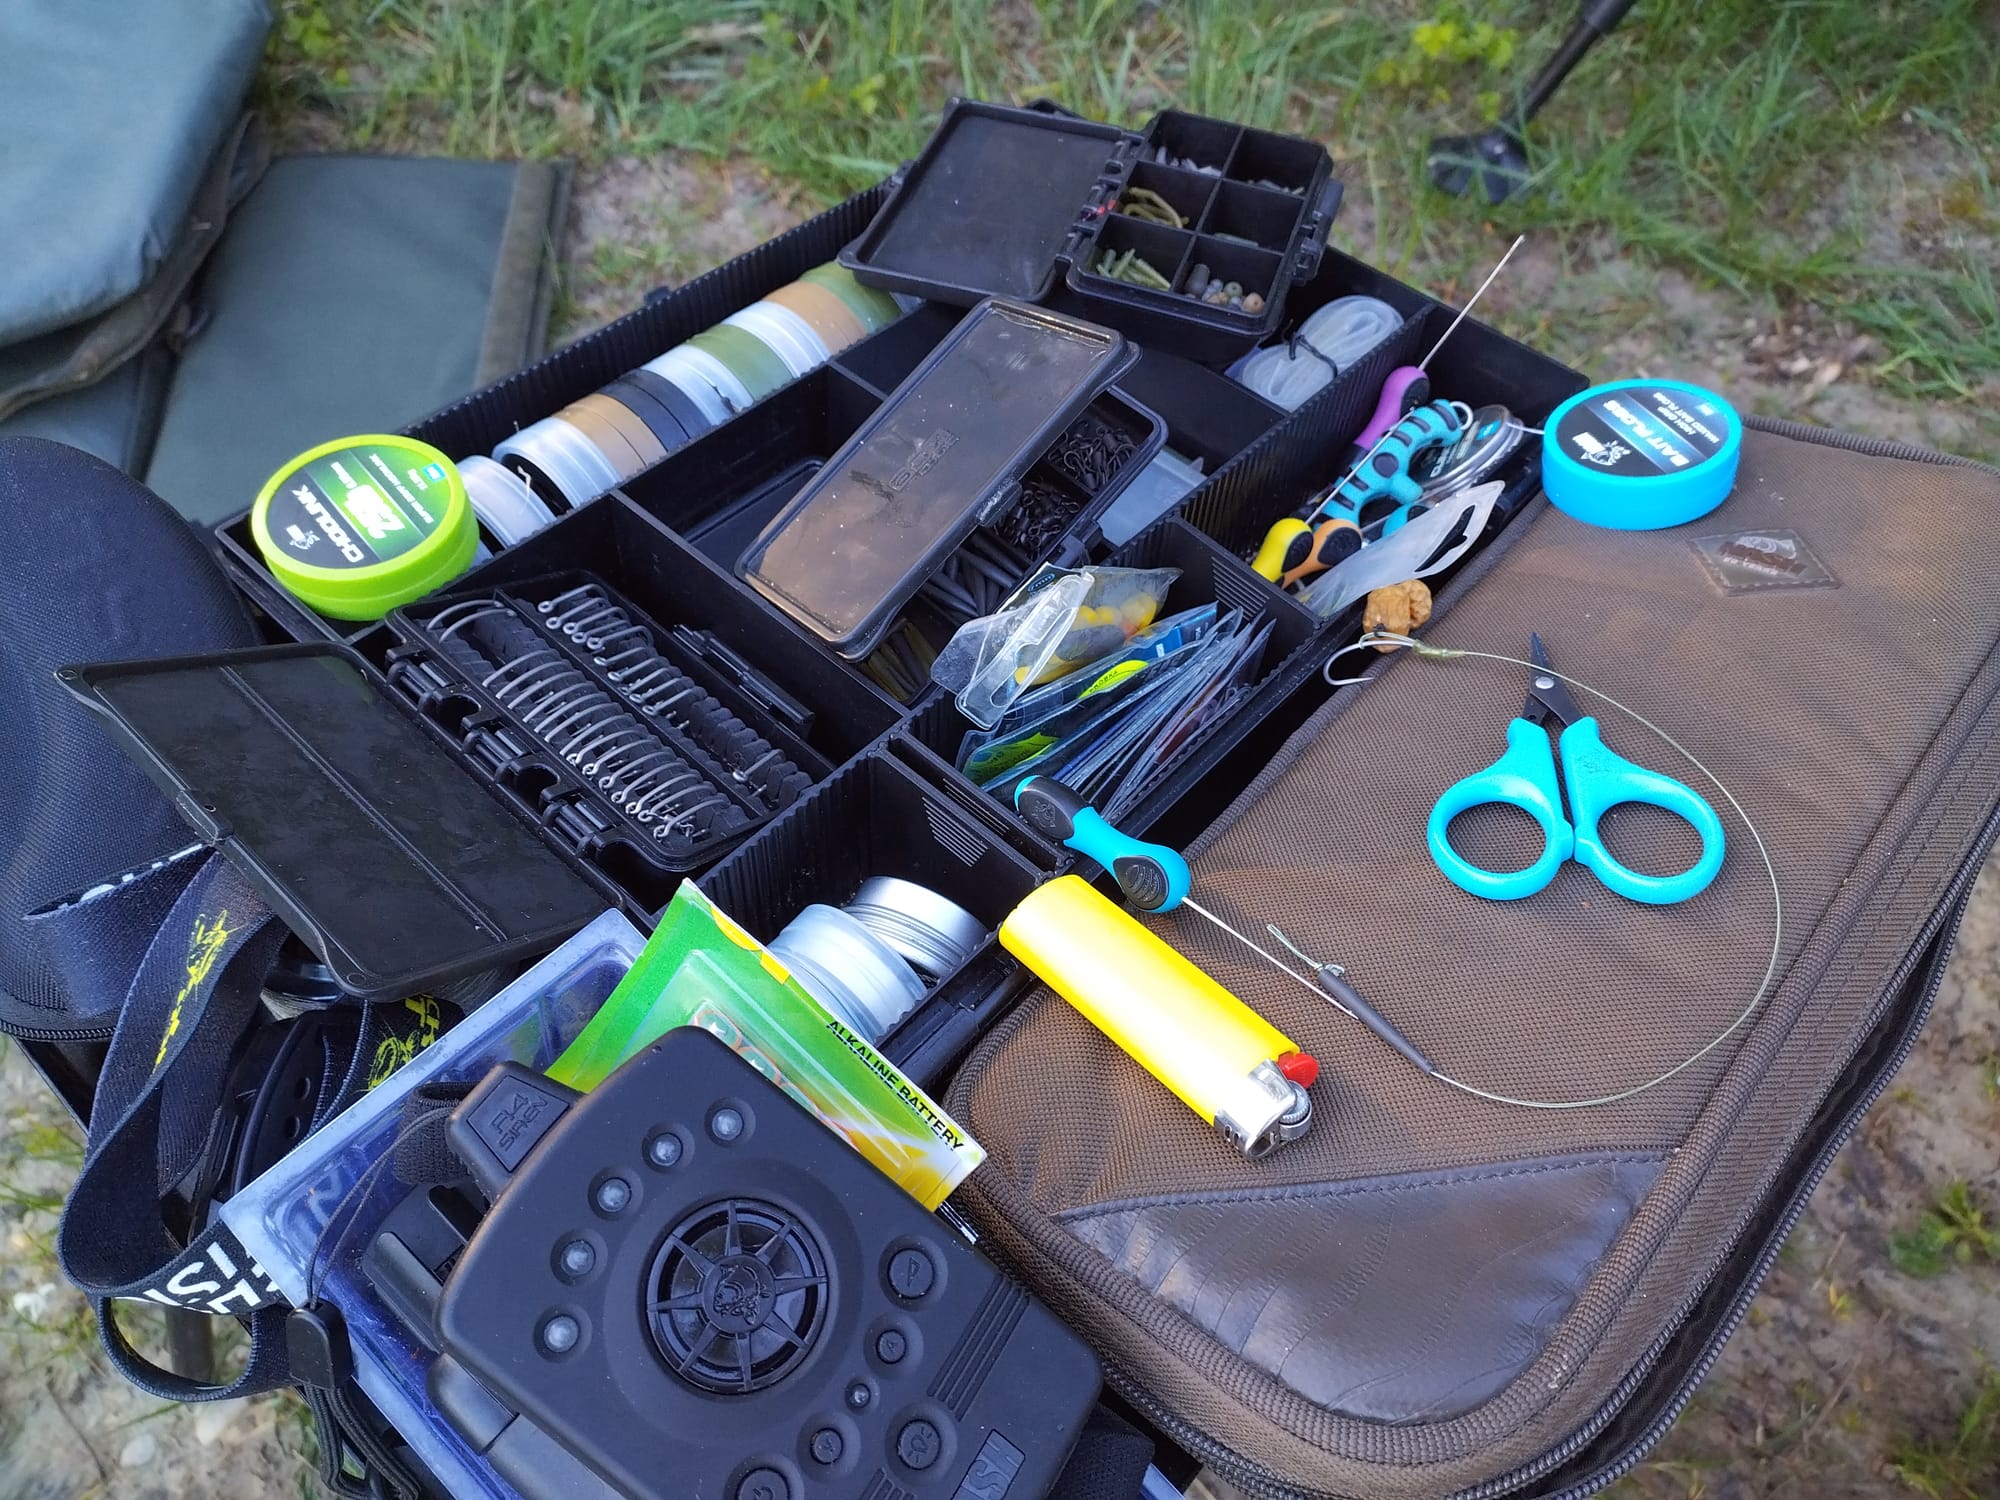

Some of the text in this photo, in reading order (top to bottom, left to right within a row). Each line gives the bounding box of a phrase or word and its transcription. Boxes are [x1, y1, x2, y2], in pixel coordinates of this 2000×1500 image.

[1603, 400, 1690, 467] BAIT FLOSS
[826, 1020, 964, 1150] ALKALINE BATTERY
[498, 1096, 549, 1152] SIREN
